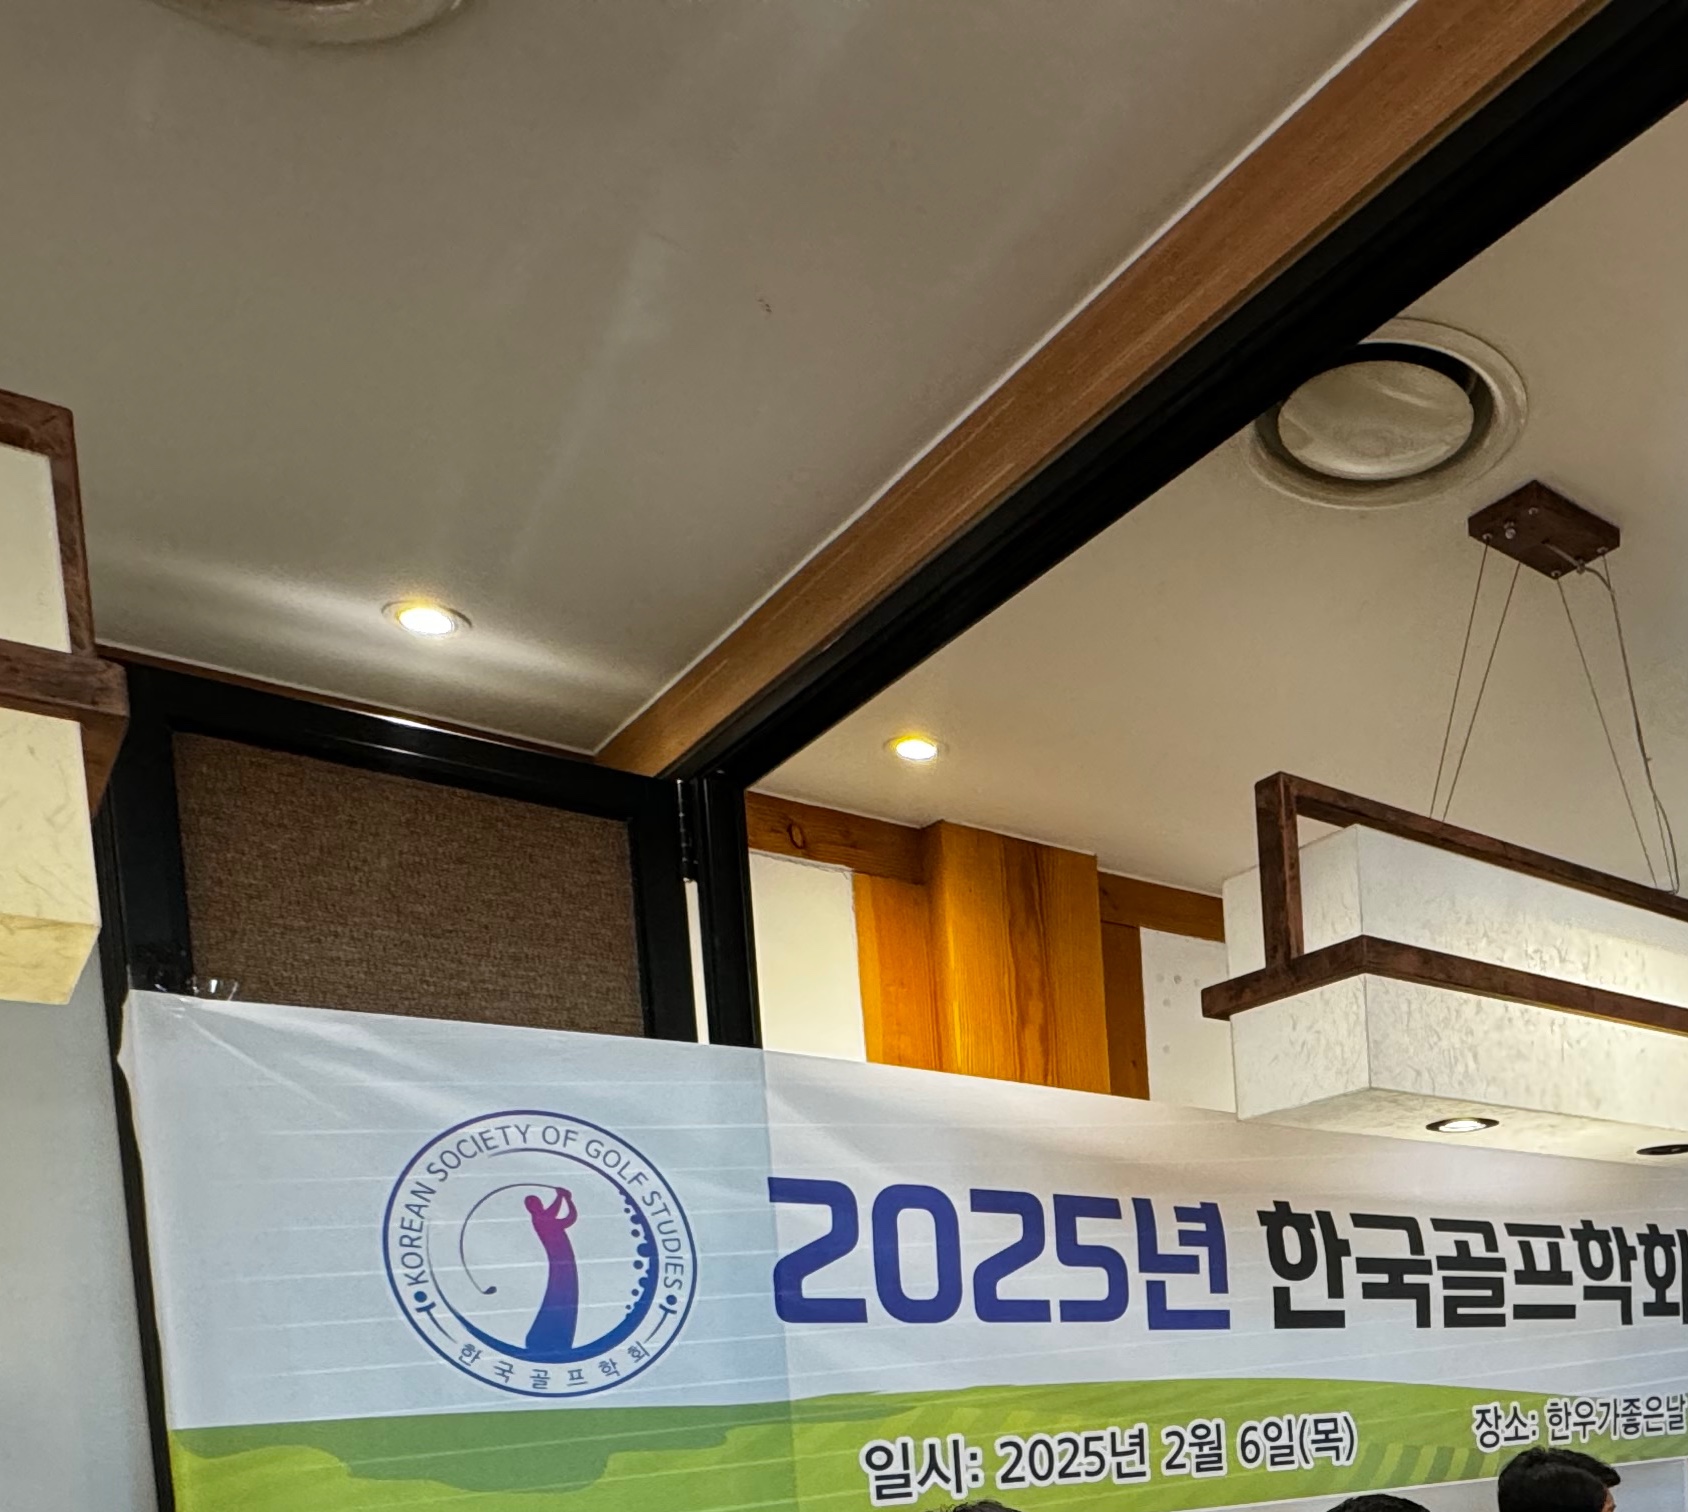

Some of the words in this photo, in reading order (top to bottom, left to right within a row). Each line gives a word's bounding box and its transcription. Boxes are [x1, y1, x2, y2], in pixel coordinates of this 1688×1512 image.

[400, 1181, 437, 1286] KOREAN
[426, 1124, 531, 1182] SOCIETY
[541, 1125, 579, 1148] OF
[584, 1140, 649, 1187] GOLF
[642, 1190, 684, 1290] STUDIES
[768, 1177, 1230, 1330] 2025년
[865, 1438, 980, 1500] 일시:
[999, 1427, 1147, 1482] 2025년
[1165, 1422, 1225, 1473] 2월
[1238, 1415, 1357, 1466] 6일(목)
[1475, 1405, 1537, 1449] 장소:
[1547, 1393, 1687, 1441] 한우가좋은날
